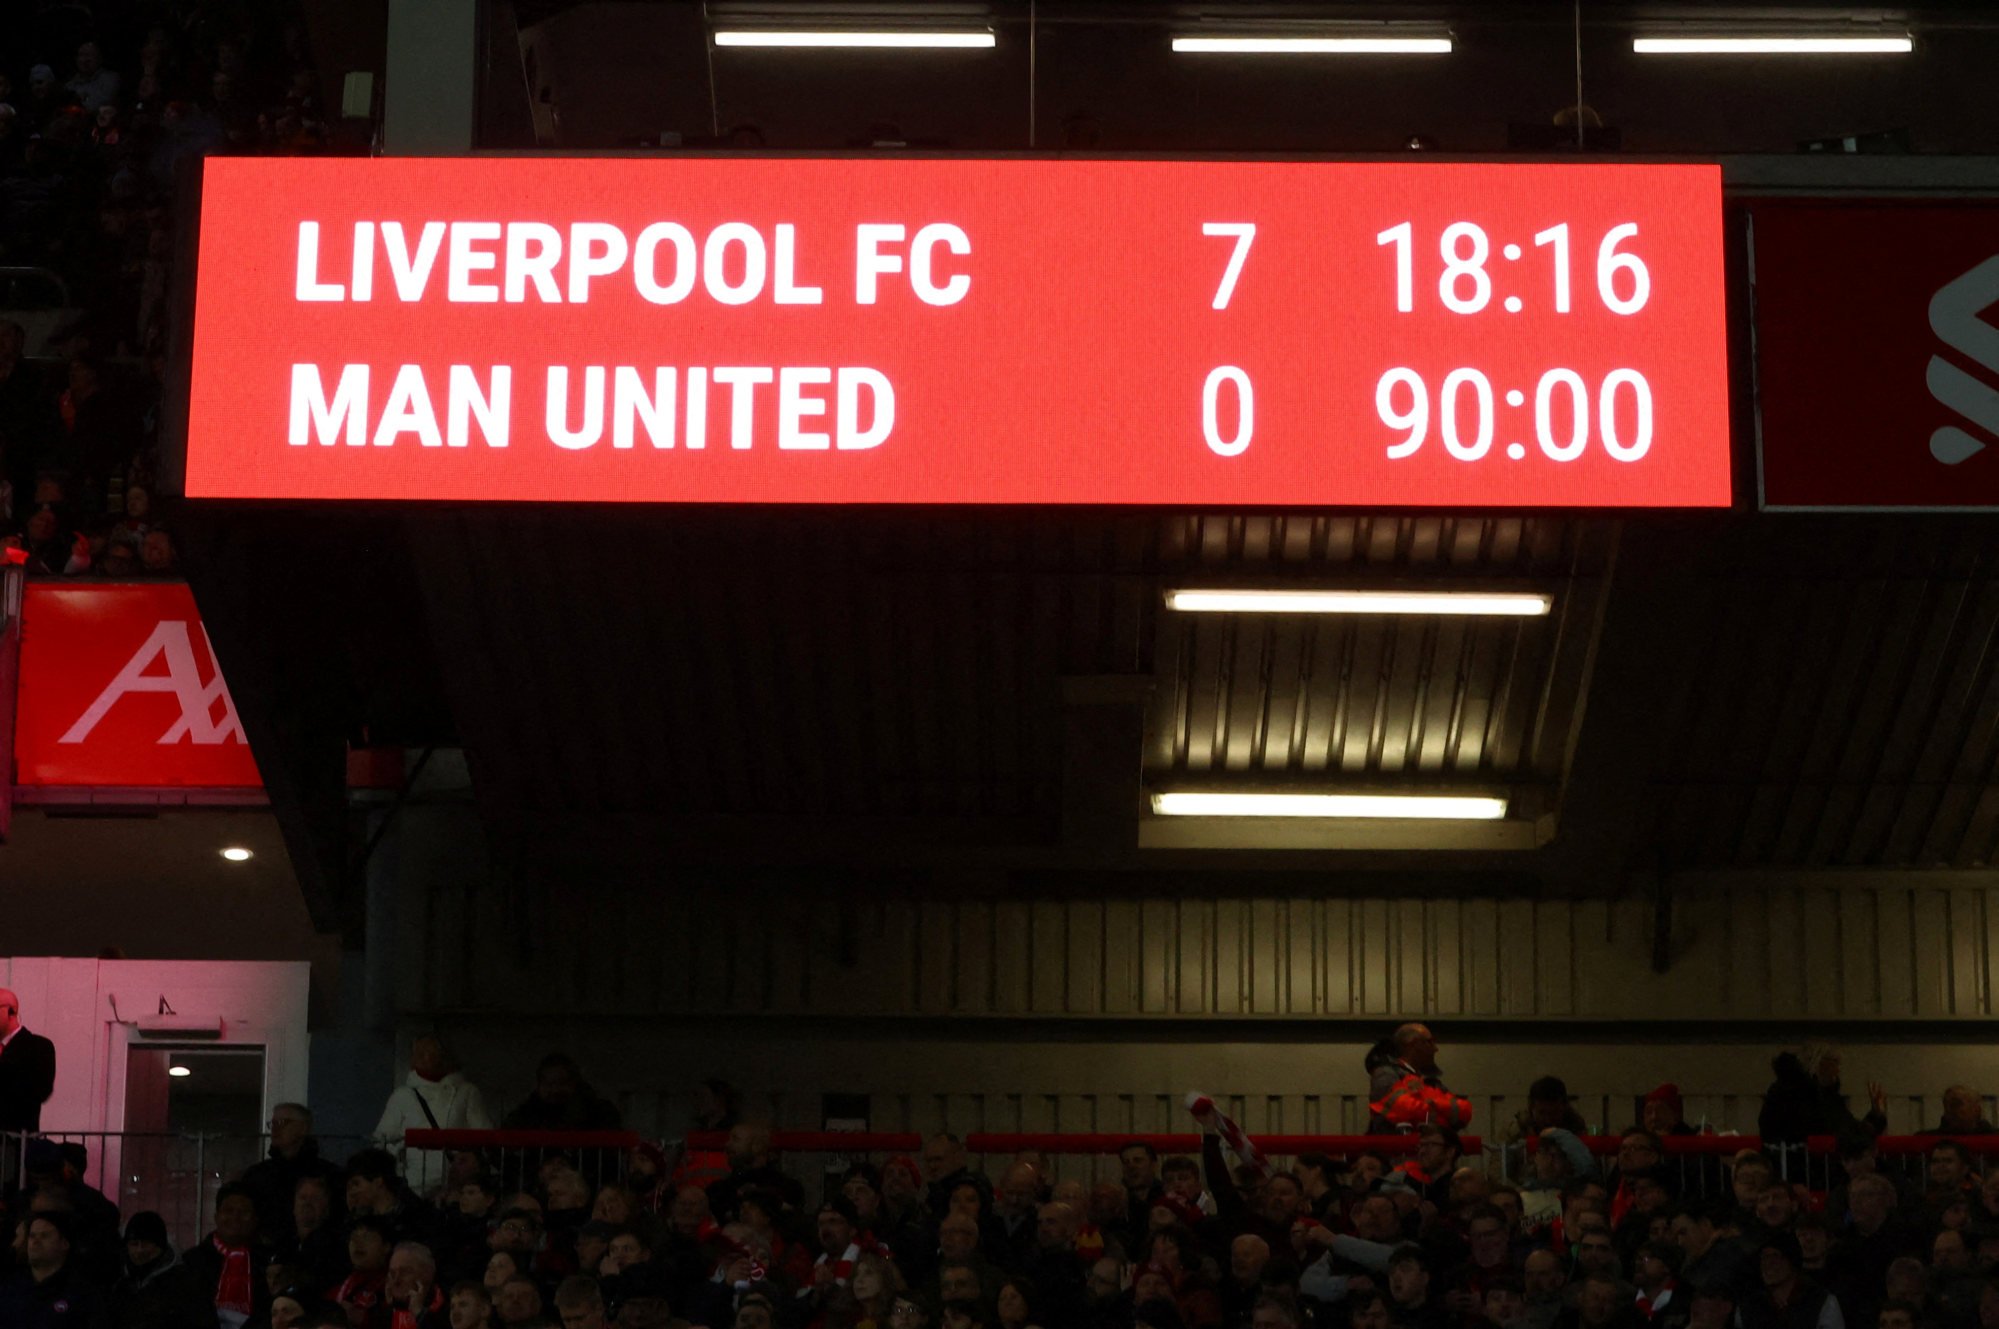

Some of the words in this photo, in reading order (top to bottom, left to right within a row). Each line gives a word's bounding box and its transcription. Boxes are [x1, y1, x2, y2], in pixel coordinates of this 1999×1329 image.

[295, 220, 823, 307] LIVERPOOL
[855, 222, 973, 308] FC
[1202, 221, 1257, 311] 7
[1376, 220, 1651, 316] 18:16
[287, 363, 513, 451] MAN
[545, 365, 897, 453] UNITED
[1202, 365, 1254, 457] 0
[1375, 366, 1654, 464] 90:00
